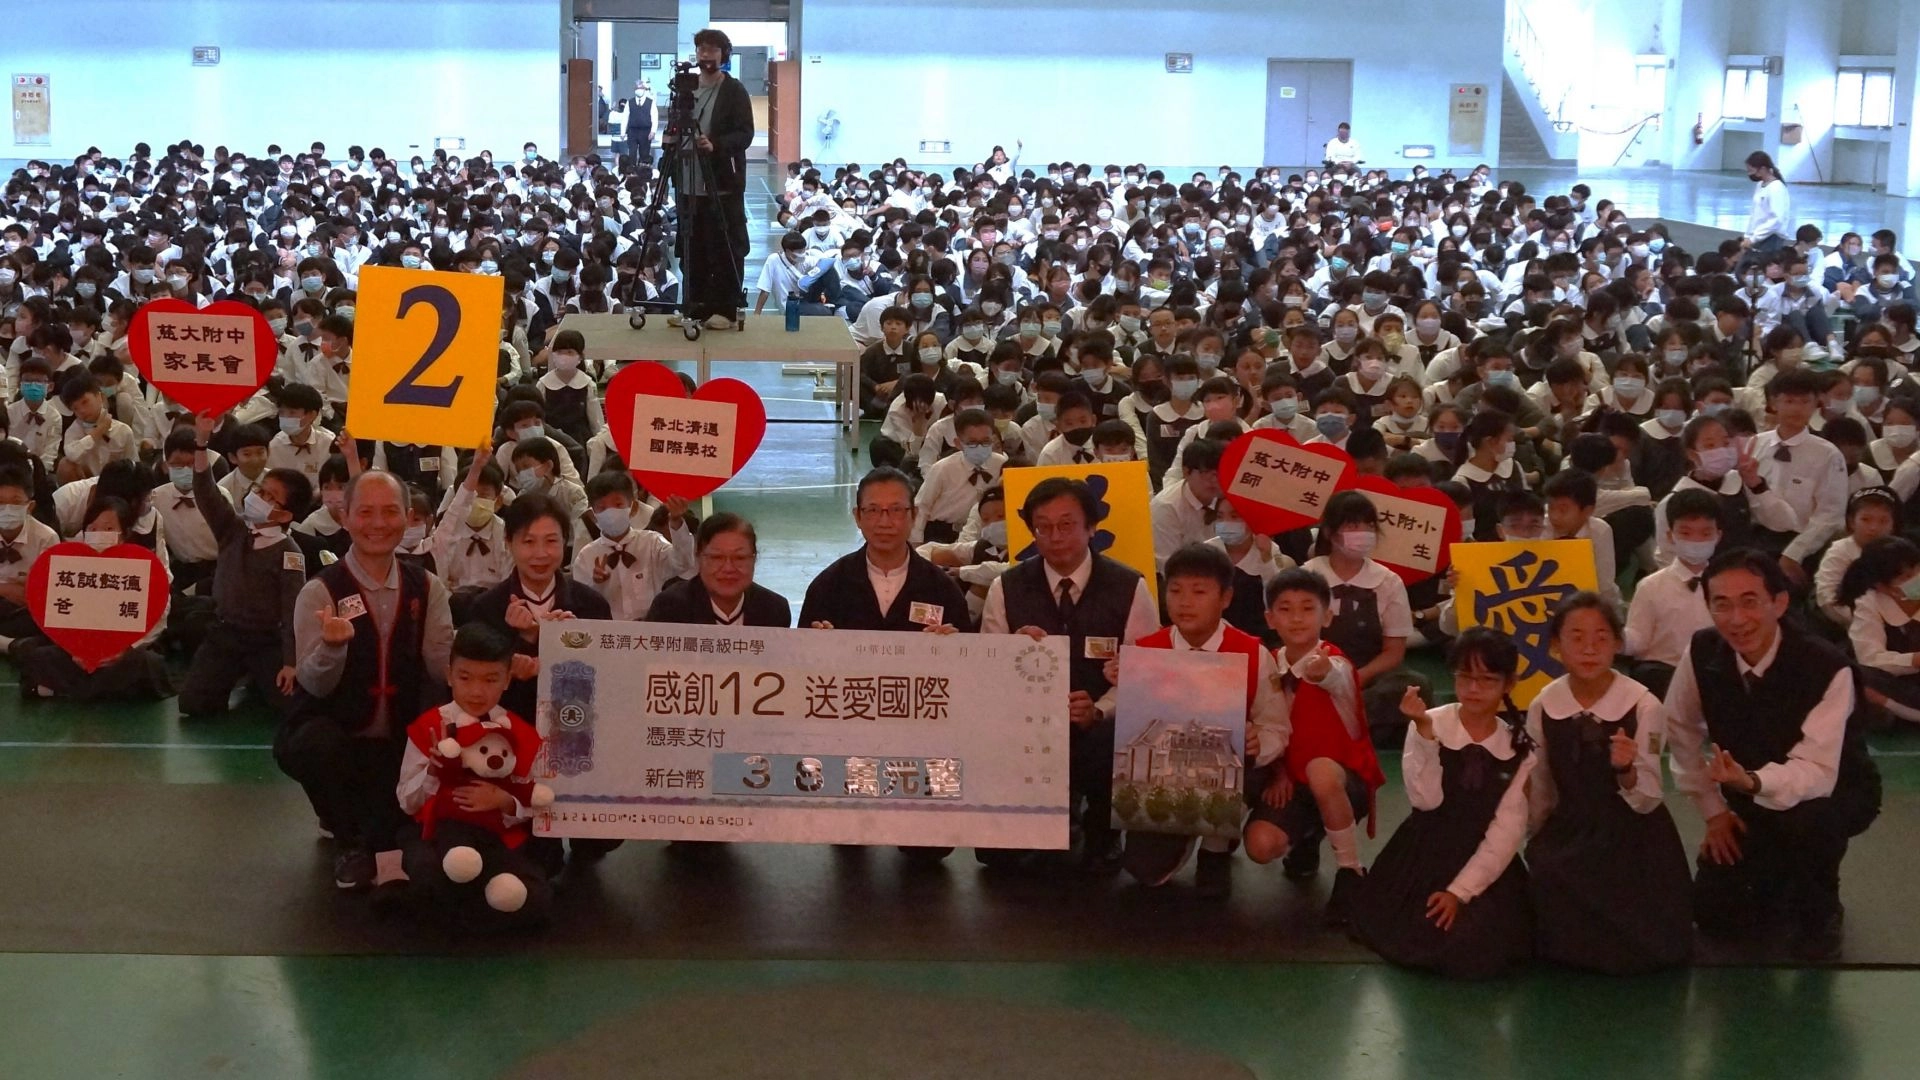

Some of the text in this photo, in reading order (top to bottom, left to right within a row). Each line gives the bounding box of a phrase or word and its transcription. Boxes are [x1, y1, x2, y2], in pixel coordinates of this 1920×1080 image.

[156, 323, 246, 344] 慈大附中
[383, 284, 464, 408] 2
[163, 352, 244, 374] 家長會
[650, 417, 719, 437] 泰北清邁
[650, 438, 718, 458] 國際學校
[1248, 450, 1332, 485] 慈大附中
[1239, 471, 1321, 508] 師 生
[1375, 510, 1437, 535] 大附小
[1412, 543, 1432, 561] 生
[55, 570, 142, 592] 慈誠懿德
[53, 598, 140, 619] 爸 媽
[1474, 550, 1580, 681] 愛
[599, 634, 766, 656] 慈濟大學附屬高級中學
[646, 671, 950, 720] 感飢12 送愛國際
[646, 726, 726, 749] 憑票支付
[645, 768, 705, 789] 新台幣
